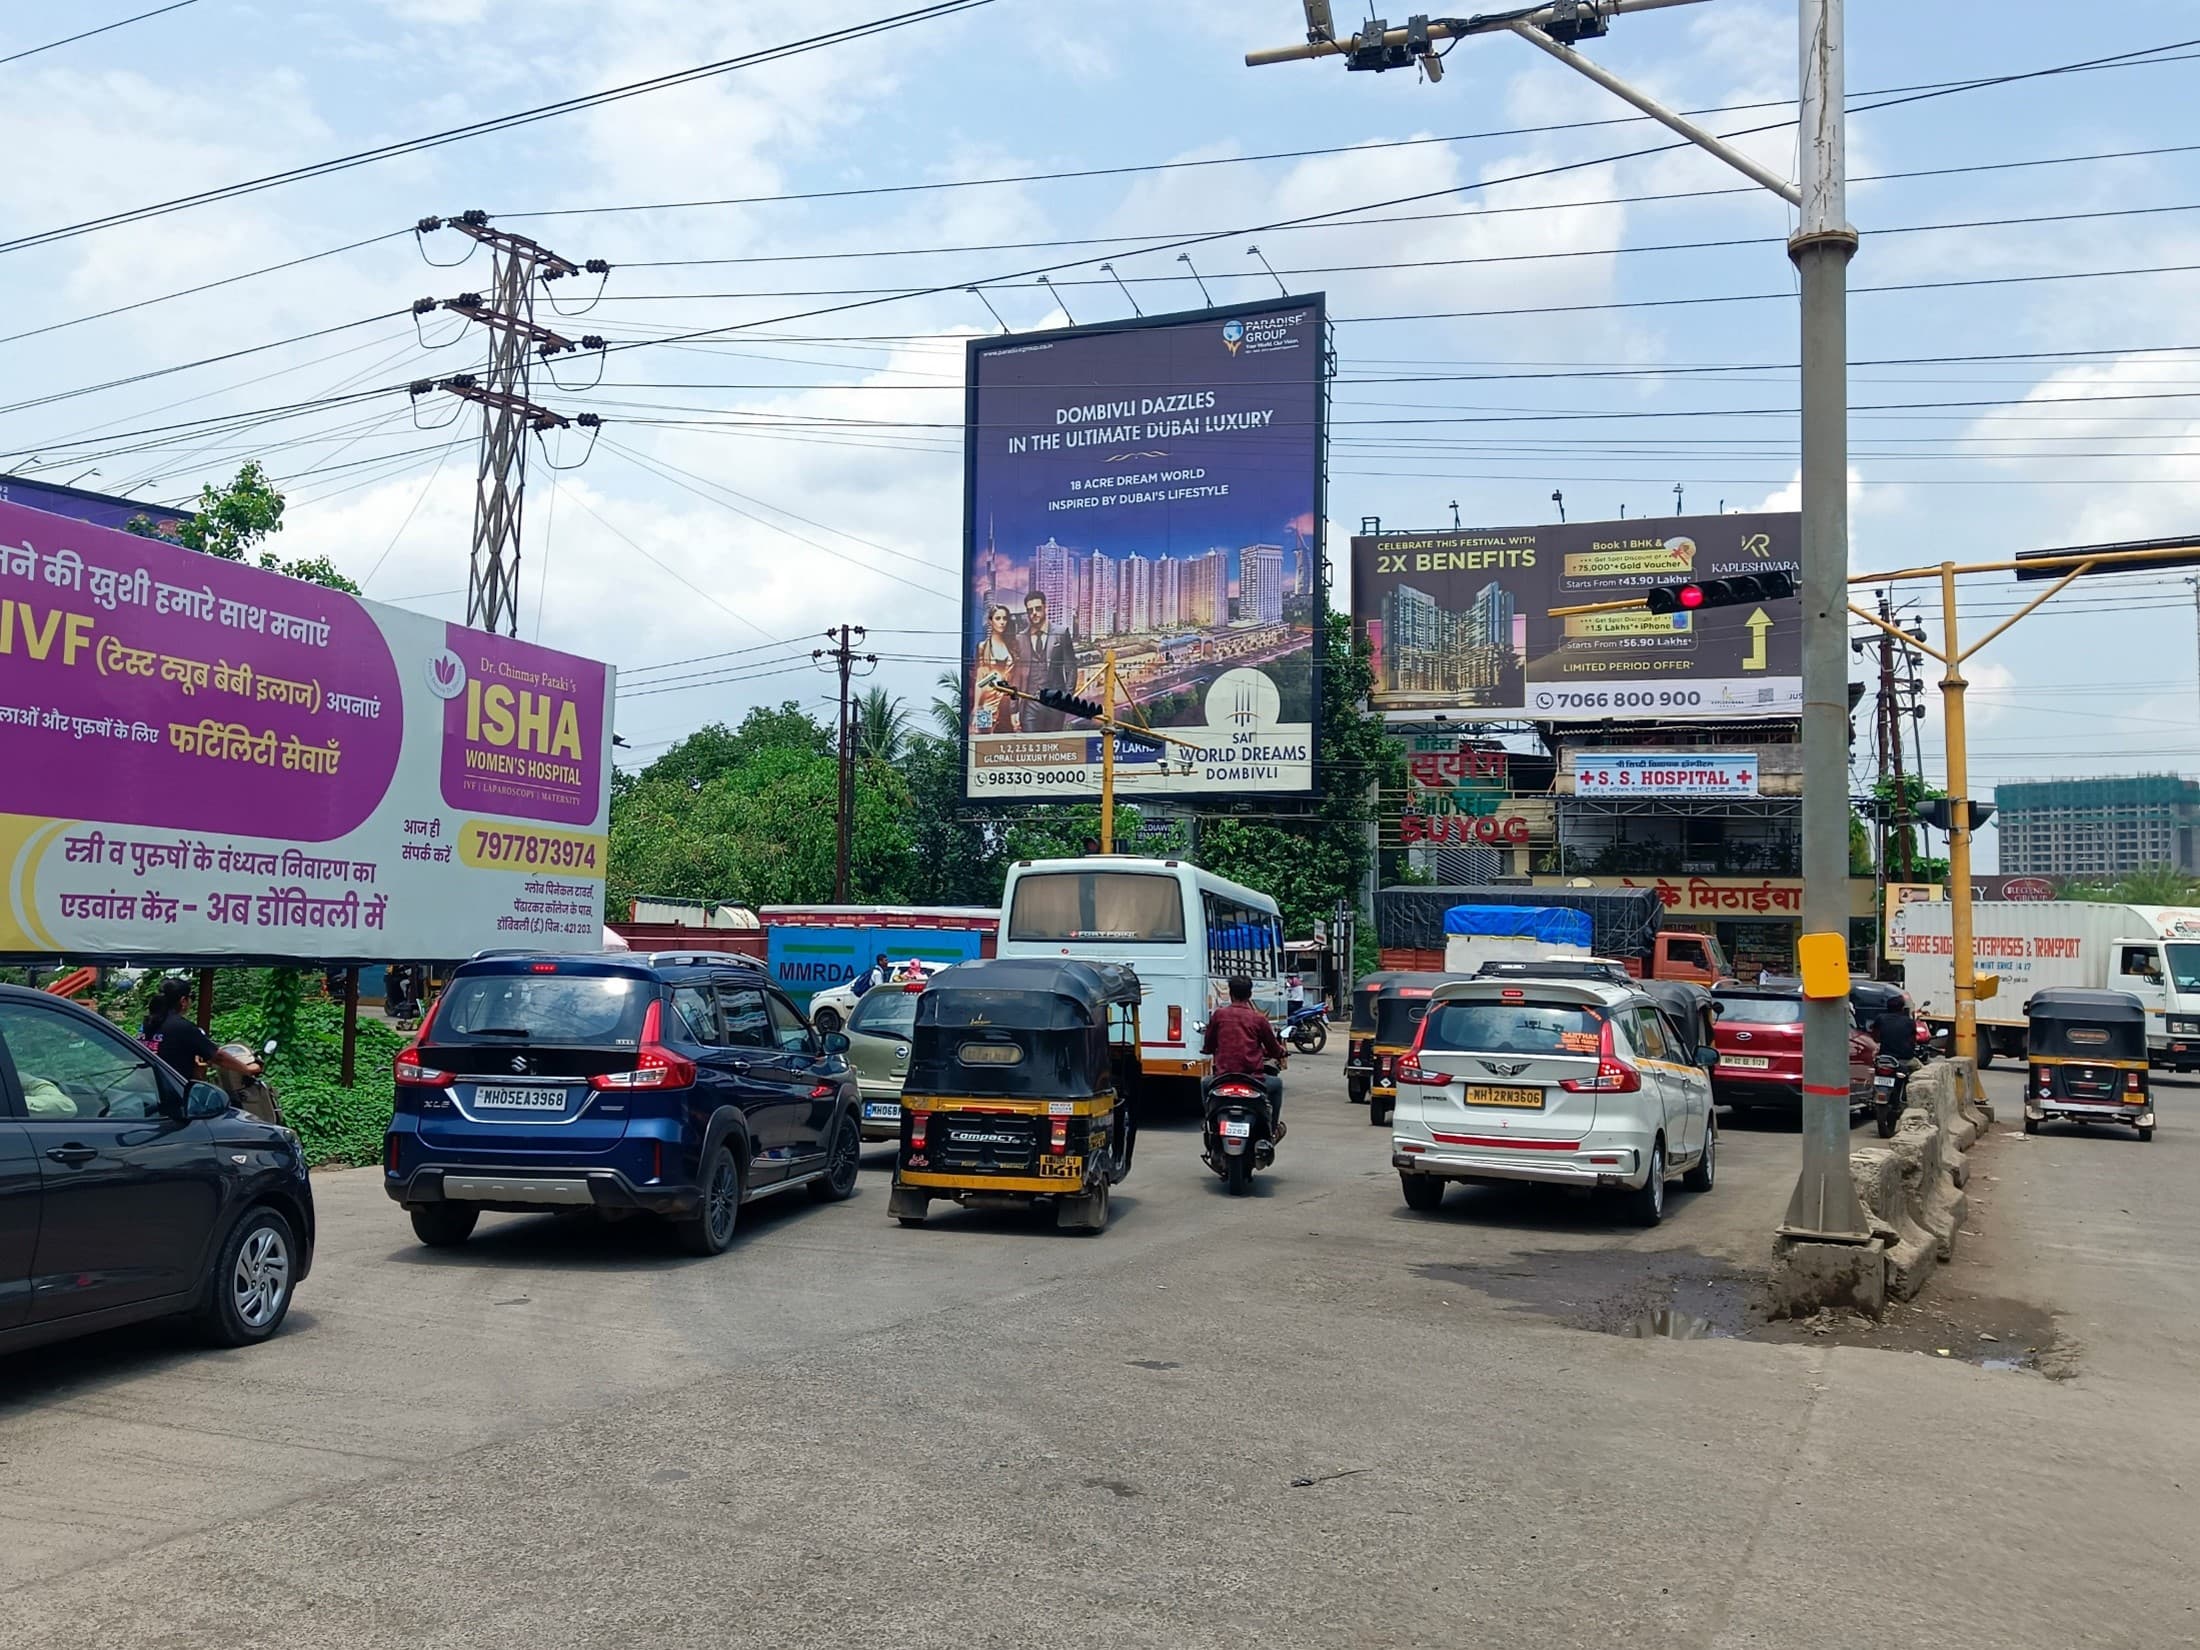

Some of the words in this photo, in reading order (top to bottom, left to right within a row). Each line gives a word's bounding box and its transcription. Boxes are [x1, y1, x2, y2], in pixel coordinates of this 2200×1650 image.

[1246, 314, 1303, 331] PARADISE
[1246, 328, 1287, 343] GROUP
[1056, 399, 1136, 425] DOMBIVLI
[1142, 391, 1216, 414] DAZZLES
[1008, 437, 1026, 454] IN
[1032, 431, 1060, 451] THE
[1066, 425, 1141, 448] ULTIMATE
[1147, 417, 1200, 439] DUBAI
[1205, 409, 1274, 431] LUXURY
[1070, 480, 1082, 491] 18
[1084, 477, 1115, 489] ACRE
[1117, 473, 1158, 486] DREAM
[1161, 468, 1205, 482] WORLD
[1048, 497, 1099, 511] INSPIRED
[1101, 493, 1116, 506] BY
[1119, 490, 1166, 505] DUBAI'S
[1168, 484, 1229, 500] LIFESTYLE
[1377, 541, 1433, 551] CELEBRATE
[1436, 539, 1458, 548] THIS
[1460, 538, 1506, 547] FESTIVAL
[1508, 536, 1536, 545] WITH
[1593, 541, 1620, 550] Book
[1630, 539, 1653, 549] BHK
[1655, 539, 1662, 547] &
[1376, 554, 1407, 573] 2X
[1416, 549, 1537, 571] BENEFITS
[1644, 560, 1681, 569] Voucher
[1712, 561, 1800, 573] KAPLESHWARA
[1566, 580, 1592, 588] Starts
[1619, 576, 1654, 585] ₹43.90
[42, 549, 84, 592] की
[155, 584, 216, 621] हमारे
[219, 597, 267, 634] साथ
[270, 616, 331, 647] मनाएं
[0, 600, 95, 666] IVF
[1640, 622, 1671, 630] iPhone
[1567, 641, 1592, 649] Starts
[1619, 639, 1655, 647] ₹56.90
[480, 657, 497, 674] Dr.
[499, 662, 541, 688] Chinmay
[1563, 663, 1606, 672] LIMITED
[1609, 662, 1650, 671] PERIOD
[96, 635, 157, 676] (टेस्ट
[160, 655, 211, 696] ट्यूब
[213, 659, 253, 697] बेबी
[256, 674, 321, 714] इलाज)
[326, 691, 382, 719] अपनाएं
[1557, 692, 1608, 707] 7066
[1613, 692, 1654, 707] 800
[1659, 691, 1701, 706] 900
[466, 678, 582, 761] ISHA
[42, 708, 70, 731] और
[72, 717, 114, 740] पुरुषों
[114, 719, 129, 740] के
[131, 722, 160, 743] लिए
[168, 719, 277, 767] फर्टिलिटी
[1007, 744, 1014, 754] 2,
[1015, 743, 1027, 753] 2.5
[1028, 743, 1034, 752] &
[1035, 743, 1041, 752] 3
[1042, 742, 1059, 752] BHK
[1179, 747, 1236, 763] WORLD
[1241, 745, 1306, 762] DREAMS
[465, 748, 526, 777] WOMEN'S
[527, 760, 582, 786] HOSPITAL
[984, 754, 1014, 764] GLOBAL
[1015, 754, 1048, 763] LUXURY
[1048, 752, 1078, 762] HOMES
[989, 771, 1032, 785] 98330
[1037, 770, 1086, 783] 90000
[1206, 766, 1278, 780] DOMBIVLI
[1599, 771, 1614, 786] S.
[1620, 771, 1636, 786] S.
[1641, 771, 1730, 786] HOSPITAL
[463, 780, 476, 791] IVF
[482, 784, 536, 800] LAPAROSCOPY
[541, 791, 581, 806] MATERNITY
[403, 819, 427, 836] आज
[429, 818, 441, 838] ही
[1400, 815, 1529, 843] SUYOG
[64, 830, 104, 865] स्त्री
[109, 840, 127, 865] व
[131, 839, 192, 877] पुरुषों
[193, 841, 215, 871] के
[218, 844, 279, 877] वंध्यत्व
[282, 848, 350, 882] निवारण
[352, 862, 377, 884] का
[402, 842, 431, 862] संपर्क
[433, 845, 453, 863] करें
[476, 831, 596, 869] 7977873974
[545, 882, 574, 898] पिनेकल
[1688, 877, 1803, 913] मिठाईवा
[60, 888, 138, 920] एडवांस
[206, 892, 253, 925] अब
[256, 886, 360, 930] डोंबिवली
[363, 893, 389, 930] में
[545, 899, 569, 916] कॉलेज
[570, 902, 578, 915] के
[497, 916, 529, 932] डोंबिवली
[564, 921, 577, 935] 421
[1906, 935, 1931, 953] SHREE
[2033, 937, 2081, 959] TRANSPORT
[779, 962, 855, 982] MMRDA
[483, 1089, 564, 1107] MH05EA3968
[1473, 1088, 1540, 1104] MH12RN3606
